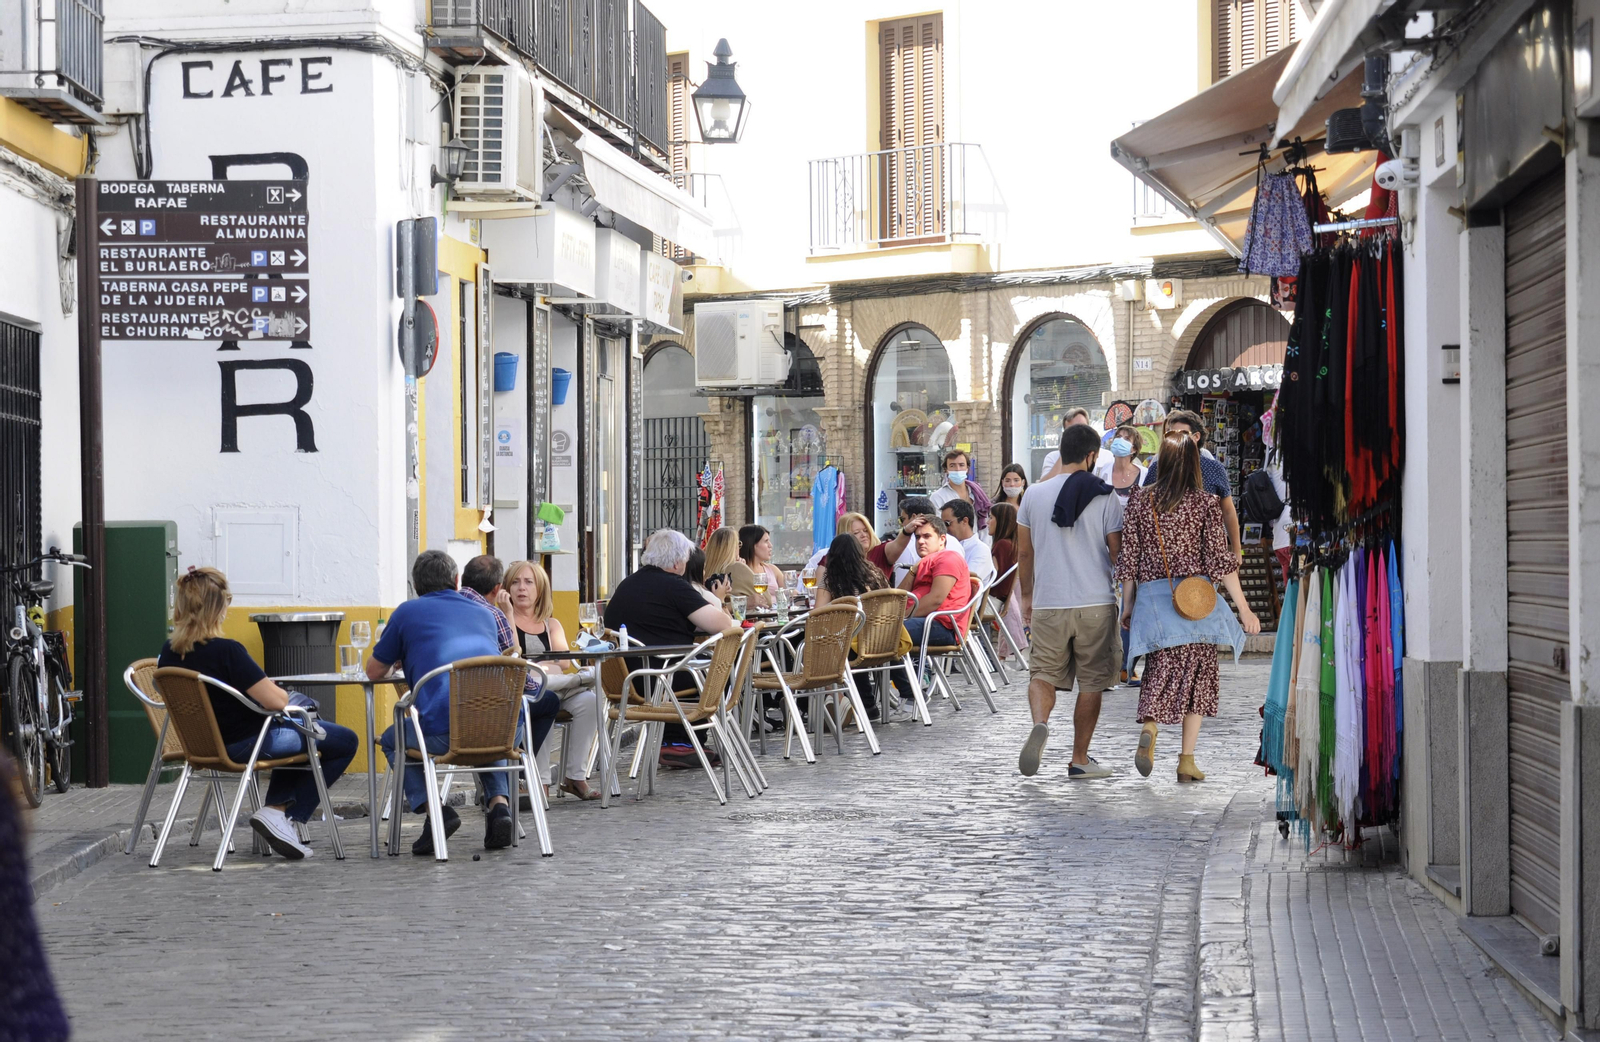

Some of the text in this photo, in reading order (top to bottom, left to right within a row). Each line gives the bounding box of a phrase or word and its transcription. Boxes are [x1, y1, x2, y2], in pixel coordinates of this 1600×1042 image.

[181, 57, 333, 99] CAFE
[100, 183, 226, 194] BODEGA TABERNA
[135, 197, 188, 208] RAFAE
[200, 215, 306, 226] RESTAURANTE
[215, 228, 306, 239] ALMUDAINA
[100, 247, 206, 259] RESTAURANTE
[100, 260, 211, 272] EL BURLAERO
[102, 281, 248, 293] TABERNA CASA PEPE
[101, 295, 226, 307] DE LA JUDERIA
[102, 313, 208, 324] RESTAURANTE
[101, 326, 120, 337] EL
[1187, 373, 1222, 390] LOS
